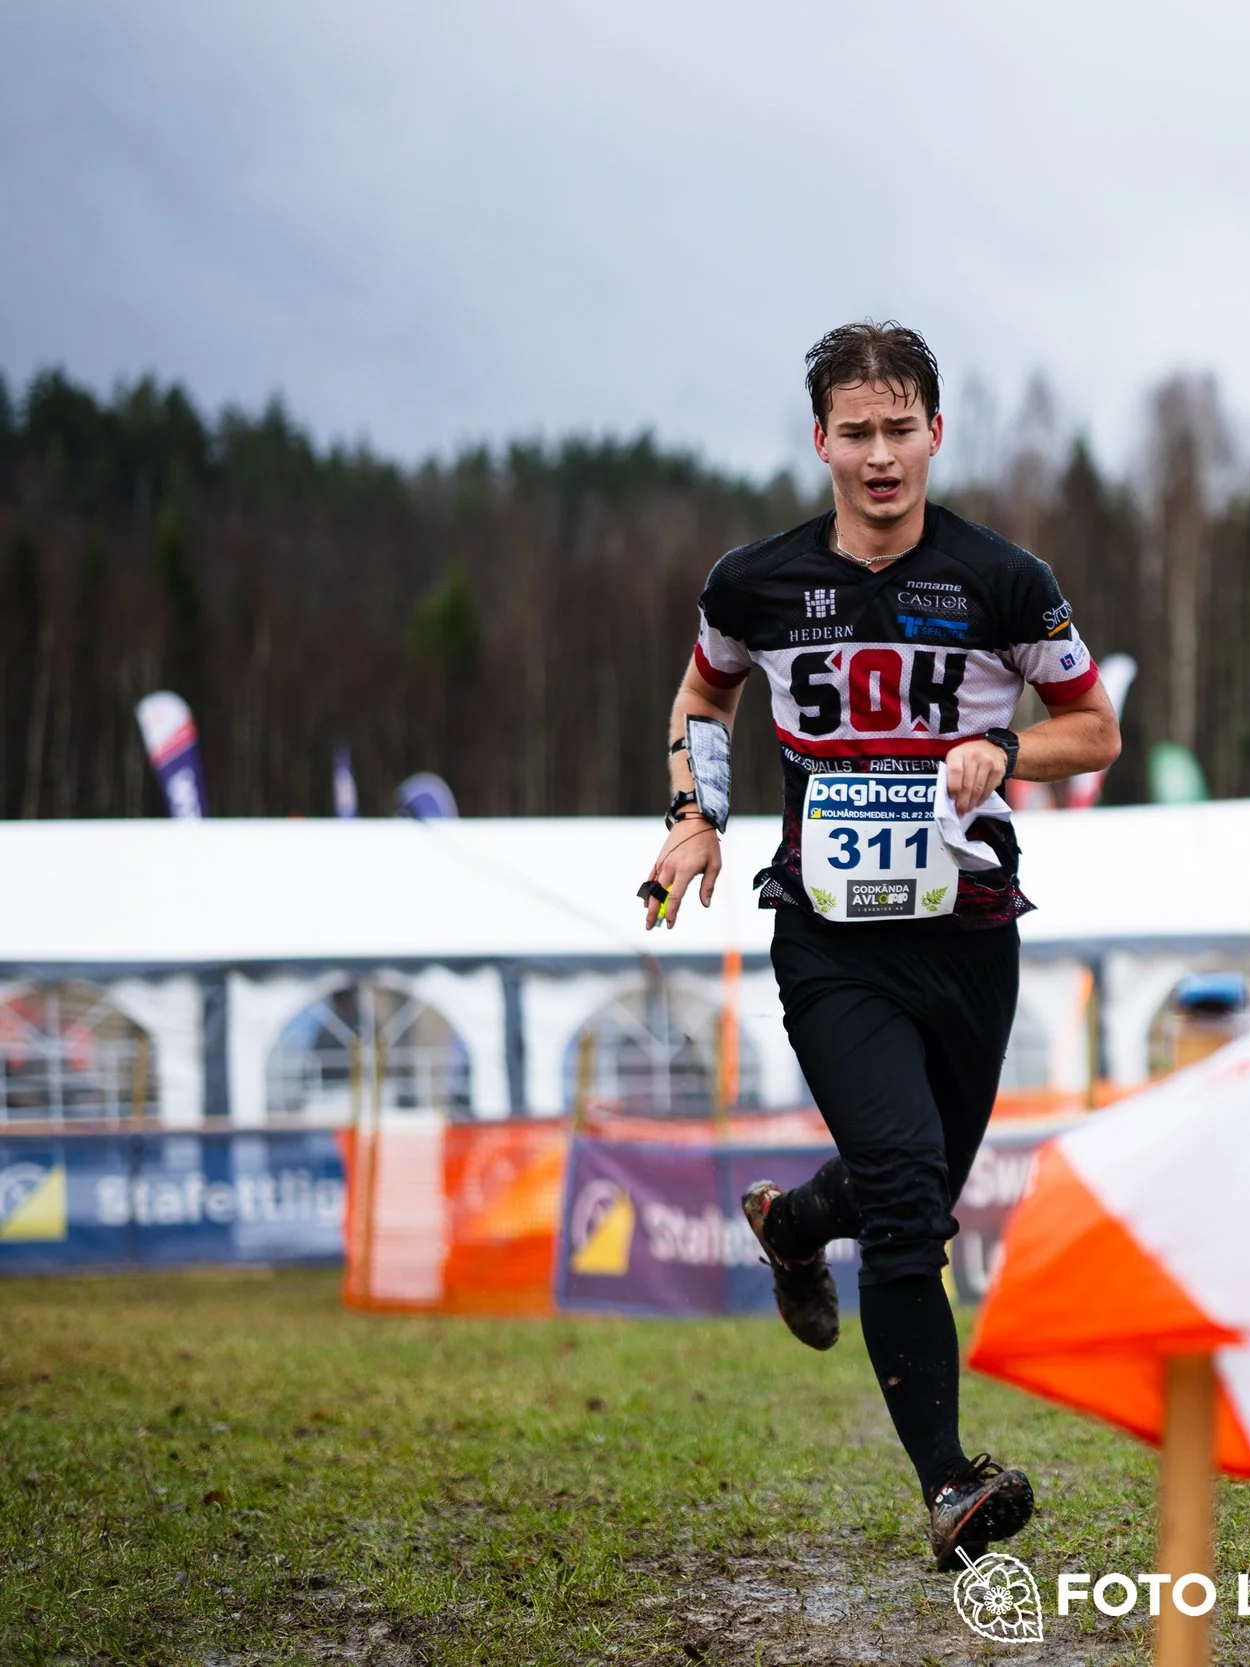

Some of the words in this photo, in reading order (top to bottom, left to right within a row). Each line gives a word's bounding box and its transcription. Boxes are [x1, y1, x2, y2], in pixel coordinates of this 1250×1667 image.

[906, 580, 962, 592] noname
[897, 592, 968, 610] CASTOR
[789, 624, 854, 642] HEDERN
[821, 807, 895, 819] KOLMÅRDSMEDELN
[901, 811, 911, 819] SL
[911, 811, 923, 819] #2
[827, 827, 928, 870] 311
[852, 883, 910, 894] GODKÄNDA
